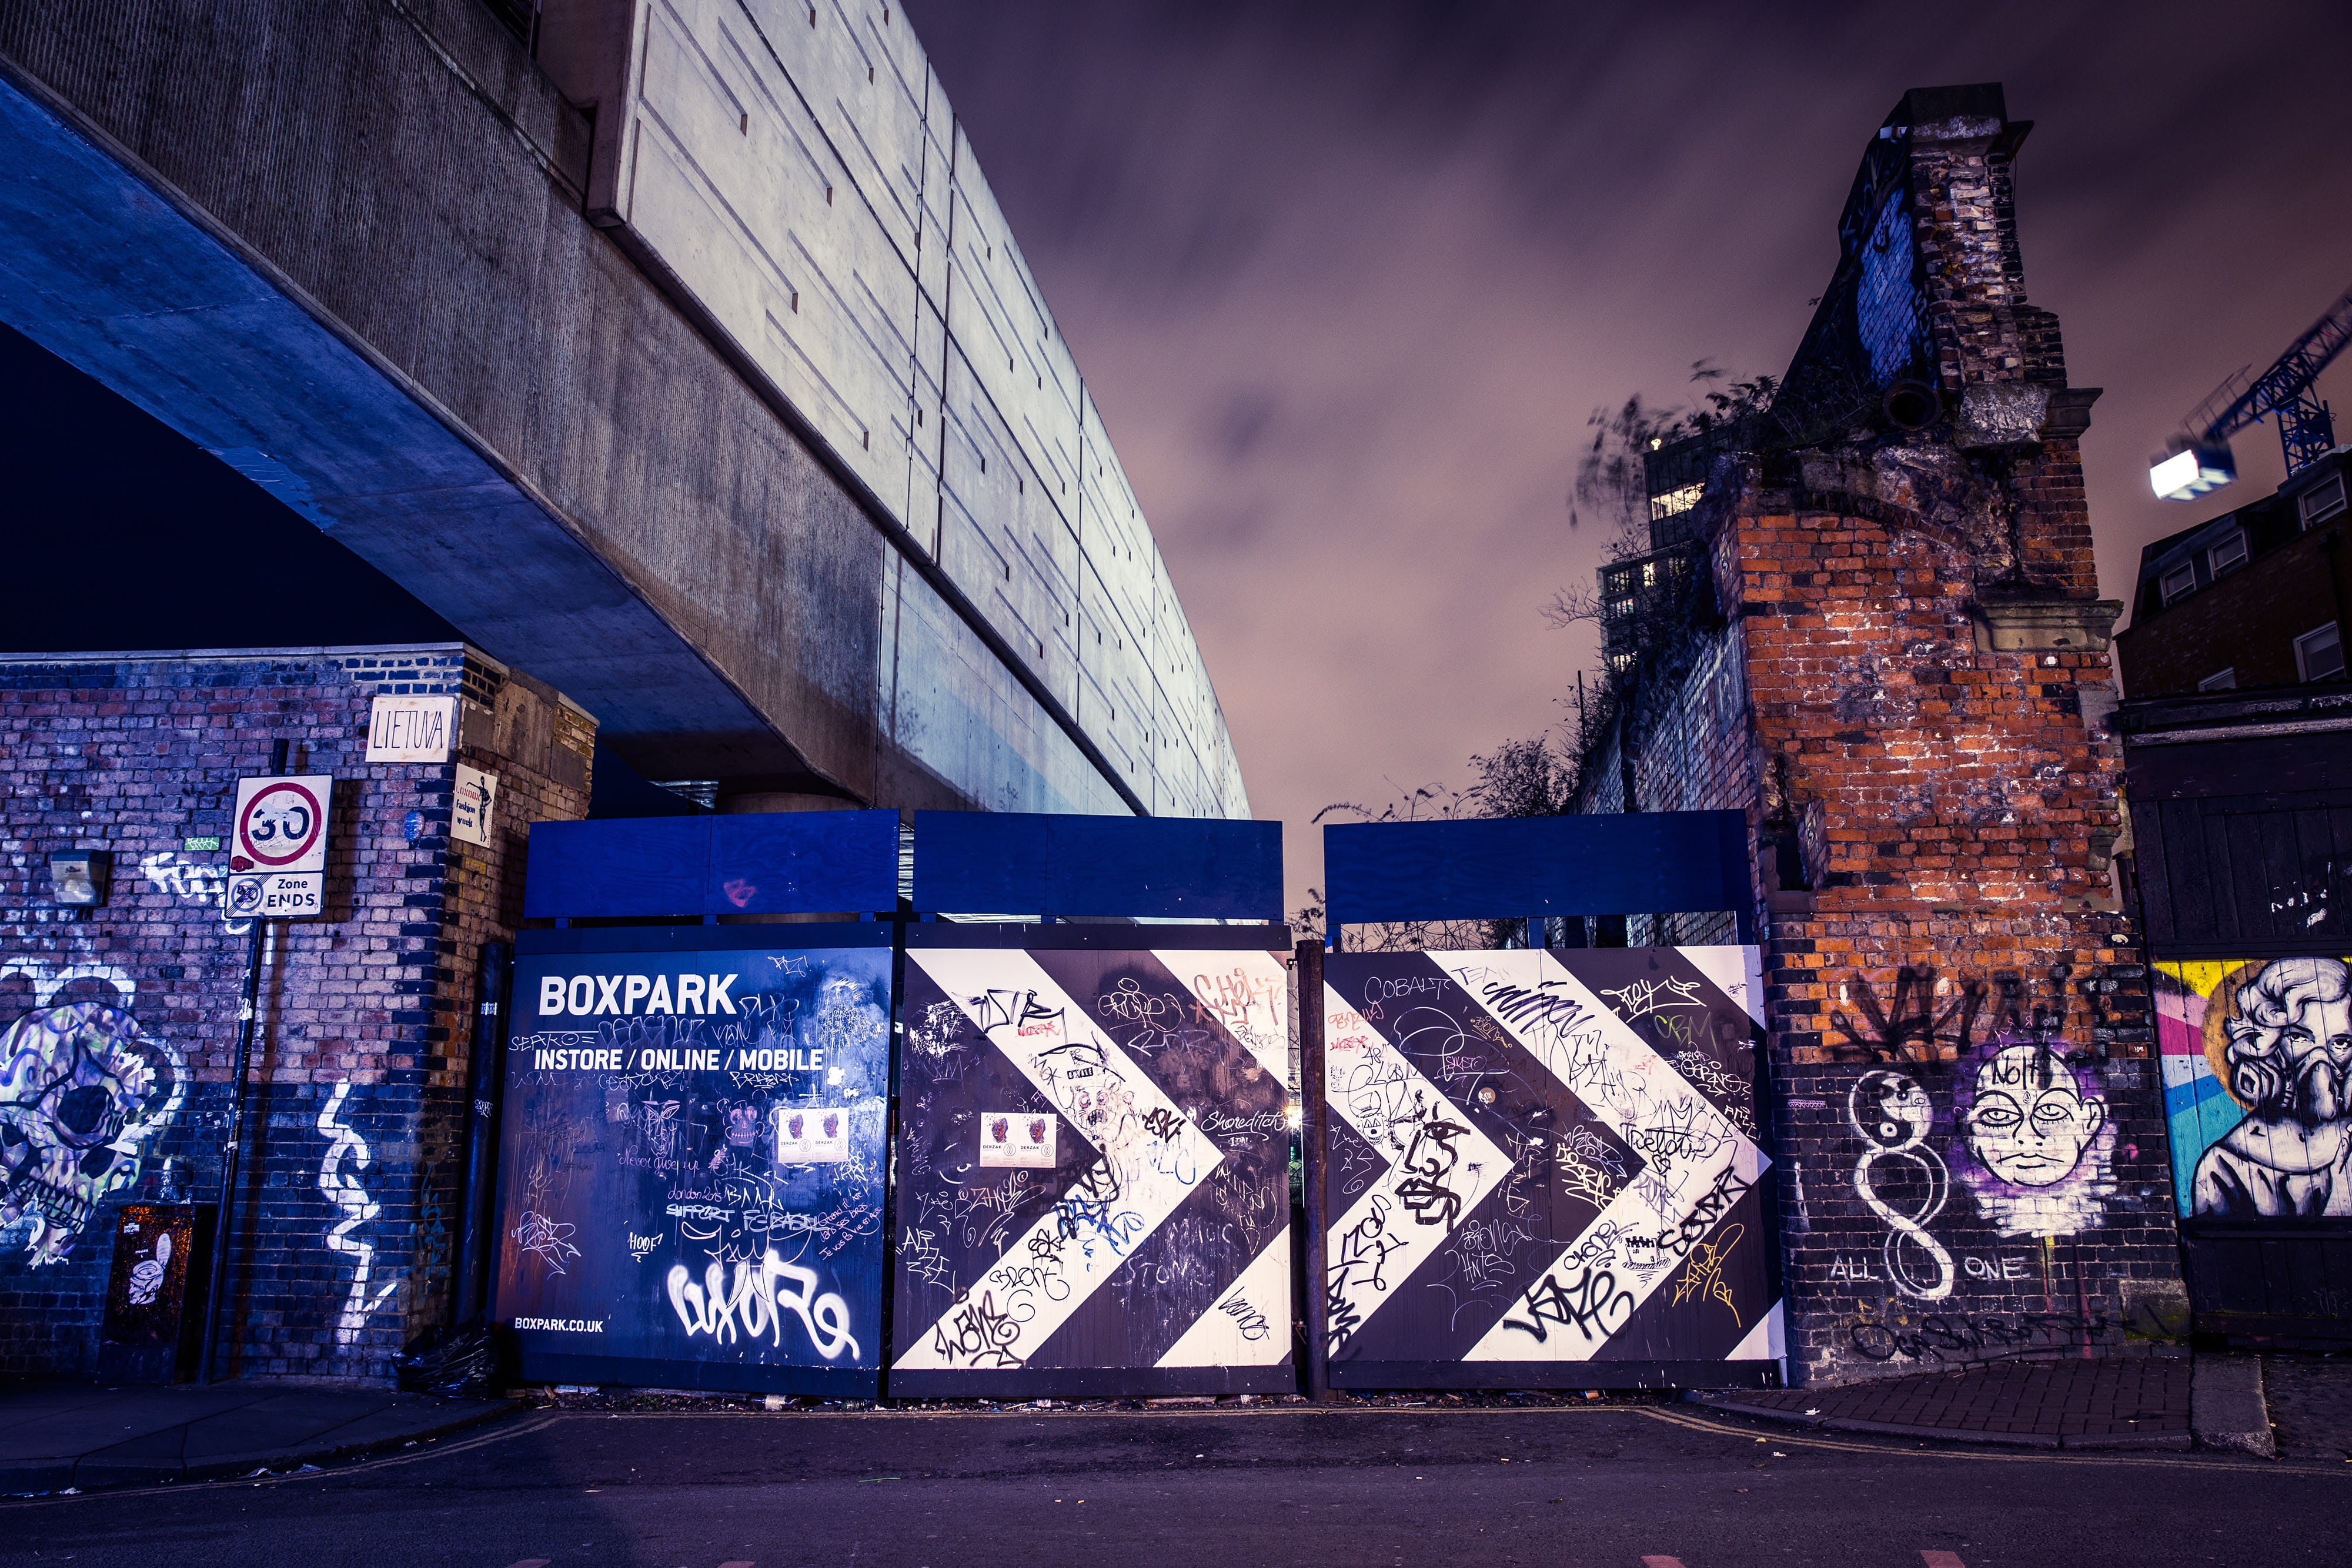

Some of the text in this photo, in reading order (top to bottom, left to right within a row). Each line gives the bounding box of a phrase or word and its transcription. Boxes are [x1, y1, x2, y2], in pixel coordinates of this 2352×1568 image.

[373, 710, 443, 749] LIETUVA
[456, 799, 476, 814] fashion
[252, 806, 310, 841] 30
[457, 816, 473, 827] week
[278, 879, 308, 889] Zone
[268, 894, 316, 907] ENDS
[538, 974, 739, 1016] BOXPARK
[1365, 977, 1451, 1004] COBALT
[534, 1048, 623, 1071] INSTORE
[641, 1048, 720, 1071] ONLINE
[740, 1048, 824, 1071] MOBILE
[1201, 1110, 1285, 1134] Shoreditch
[619, 1145, 652, 1168] Never
[818, 1246, 833, 1261] Je
[1830, 1255, 2031, 1284] ALL ONE
[514, 1317, 604, 1333] BOXPARK.CO.UK
